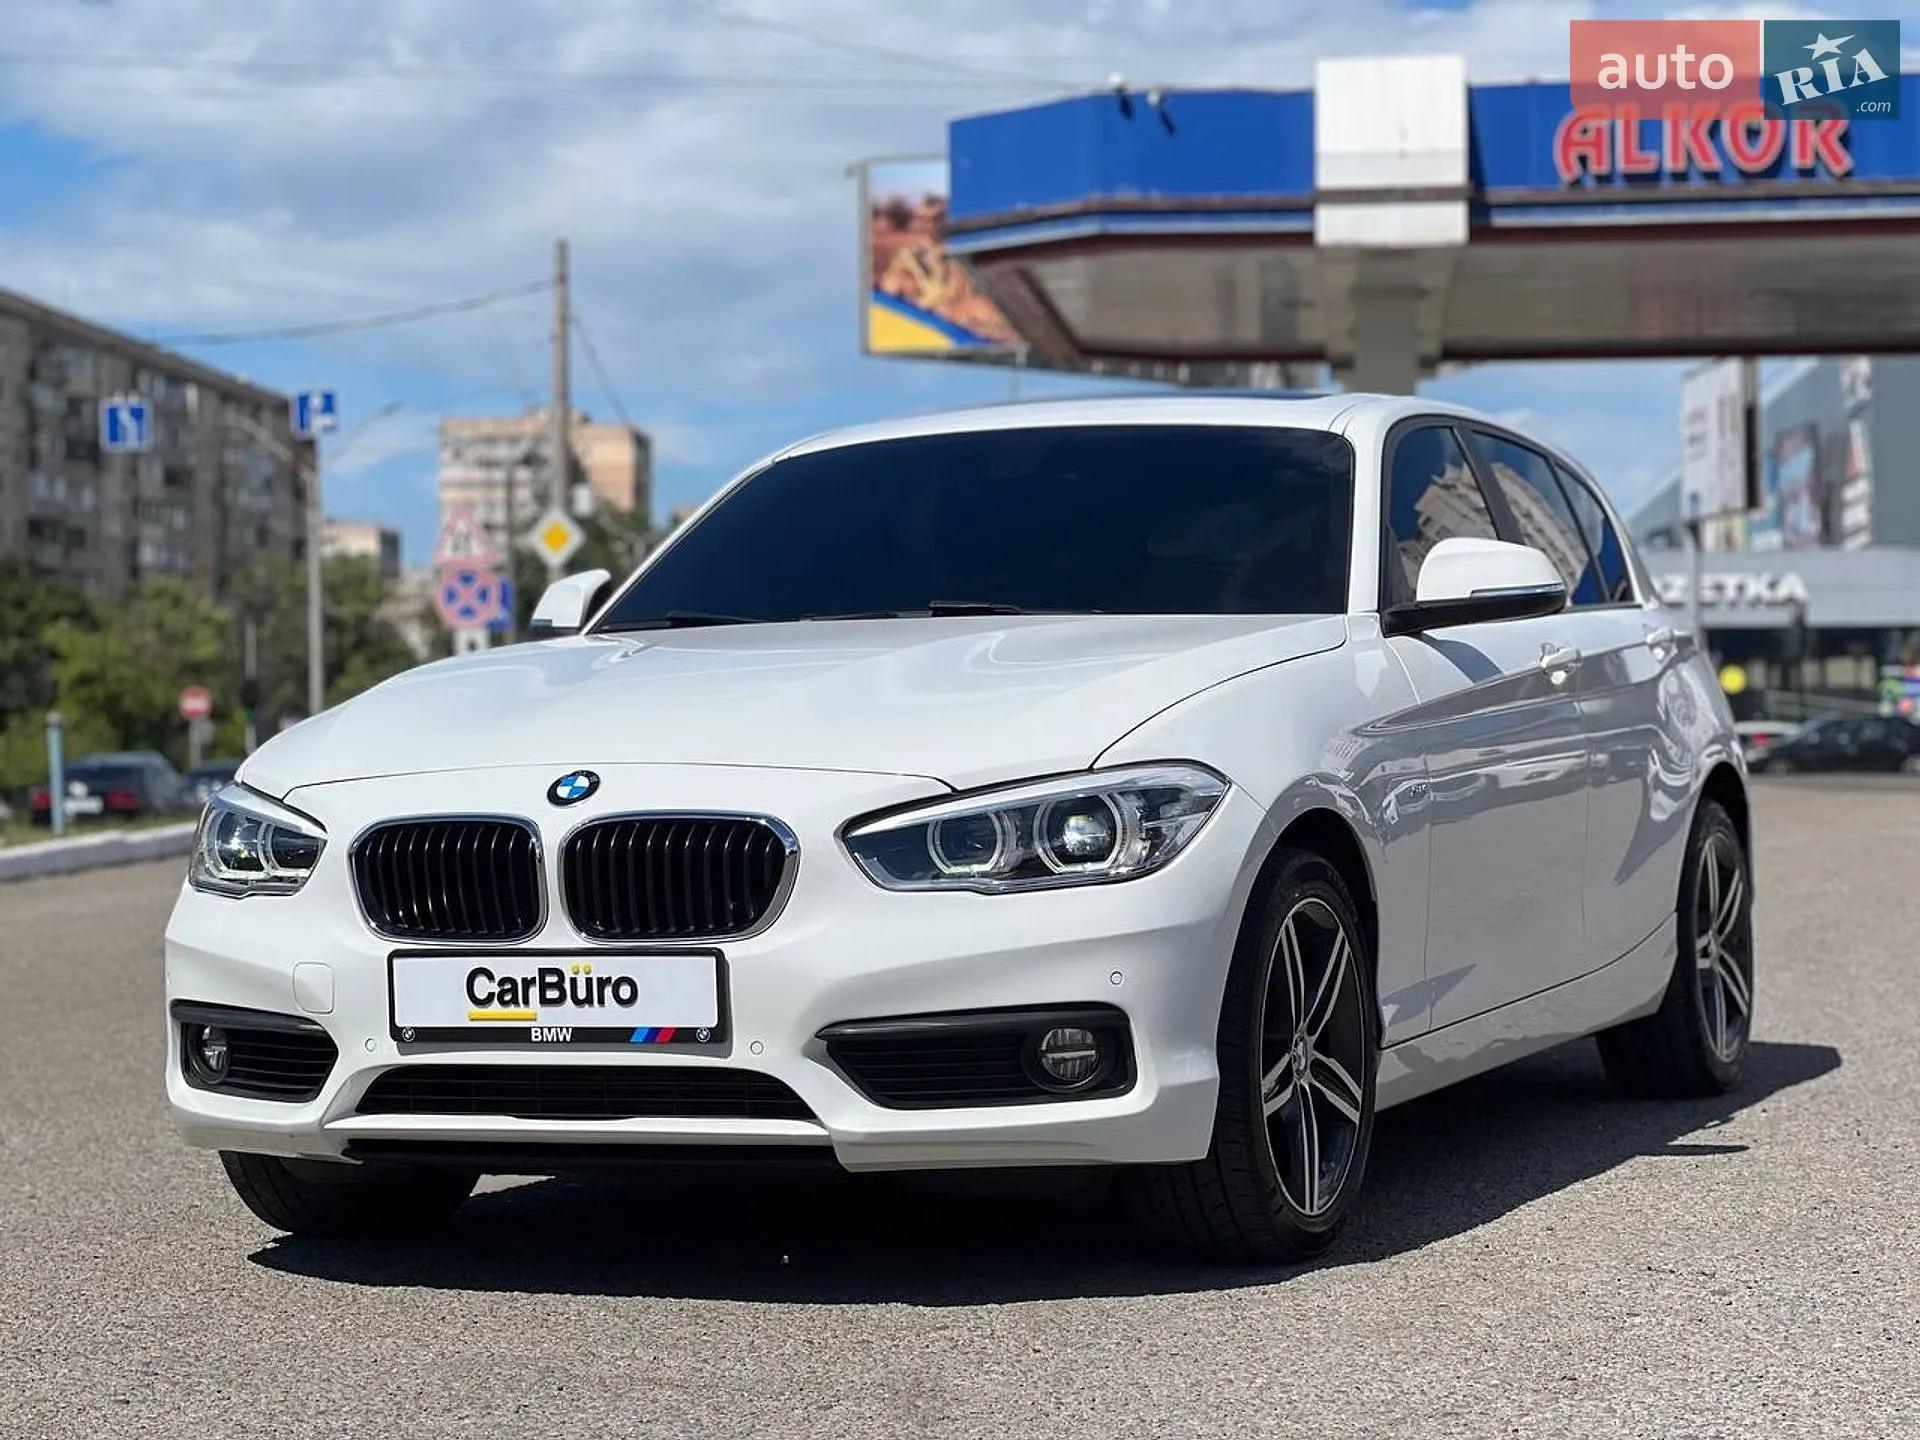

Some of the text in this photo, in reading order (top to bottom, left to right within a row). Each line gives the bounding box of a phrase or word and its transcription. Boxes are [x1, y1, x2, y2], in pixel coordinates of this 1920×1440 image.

[1553, 101, 1854, 184] ALKOR
[466, 963, 639, 1008] CarBüro
[530, 1026, 573, 1043] BMW
